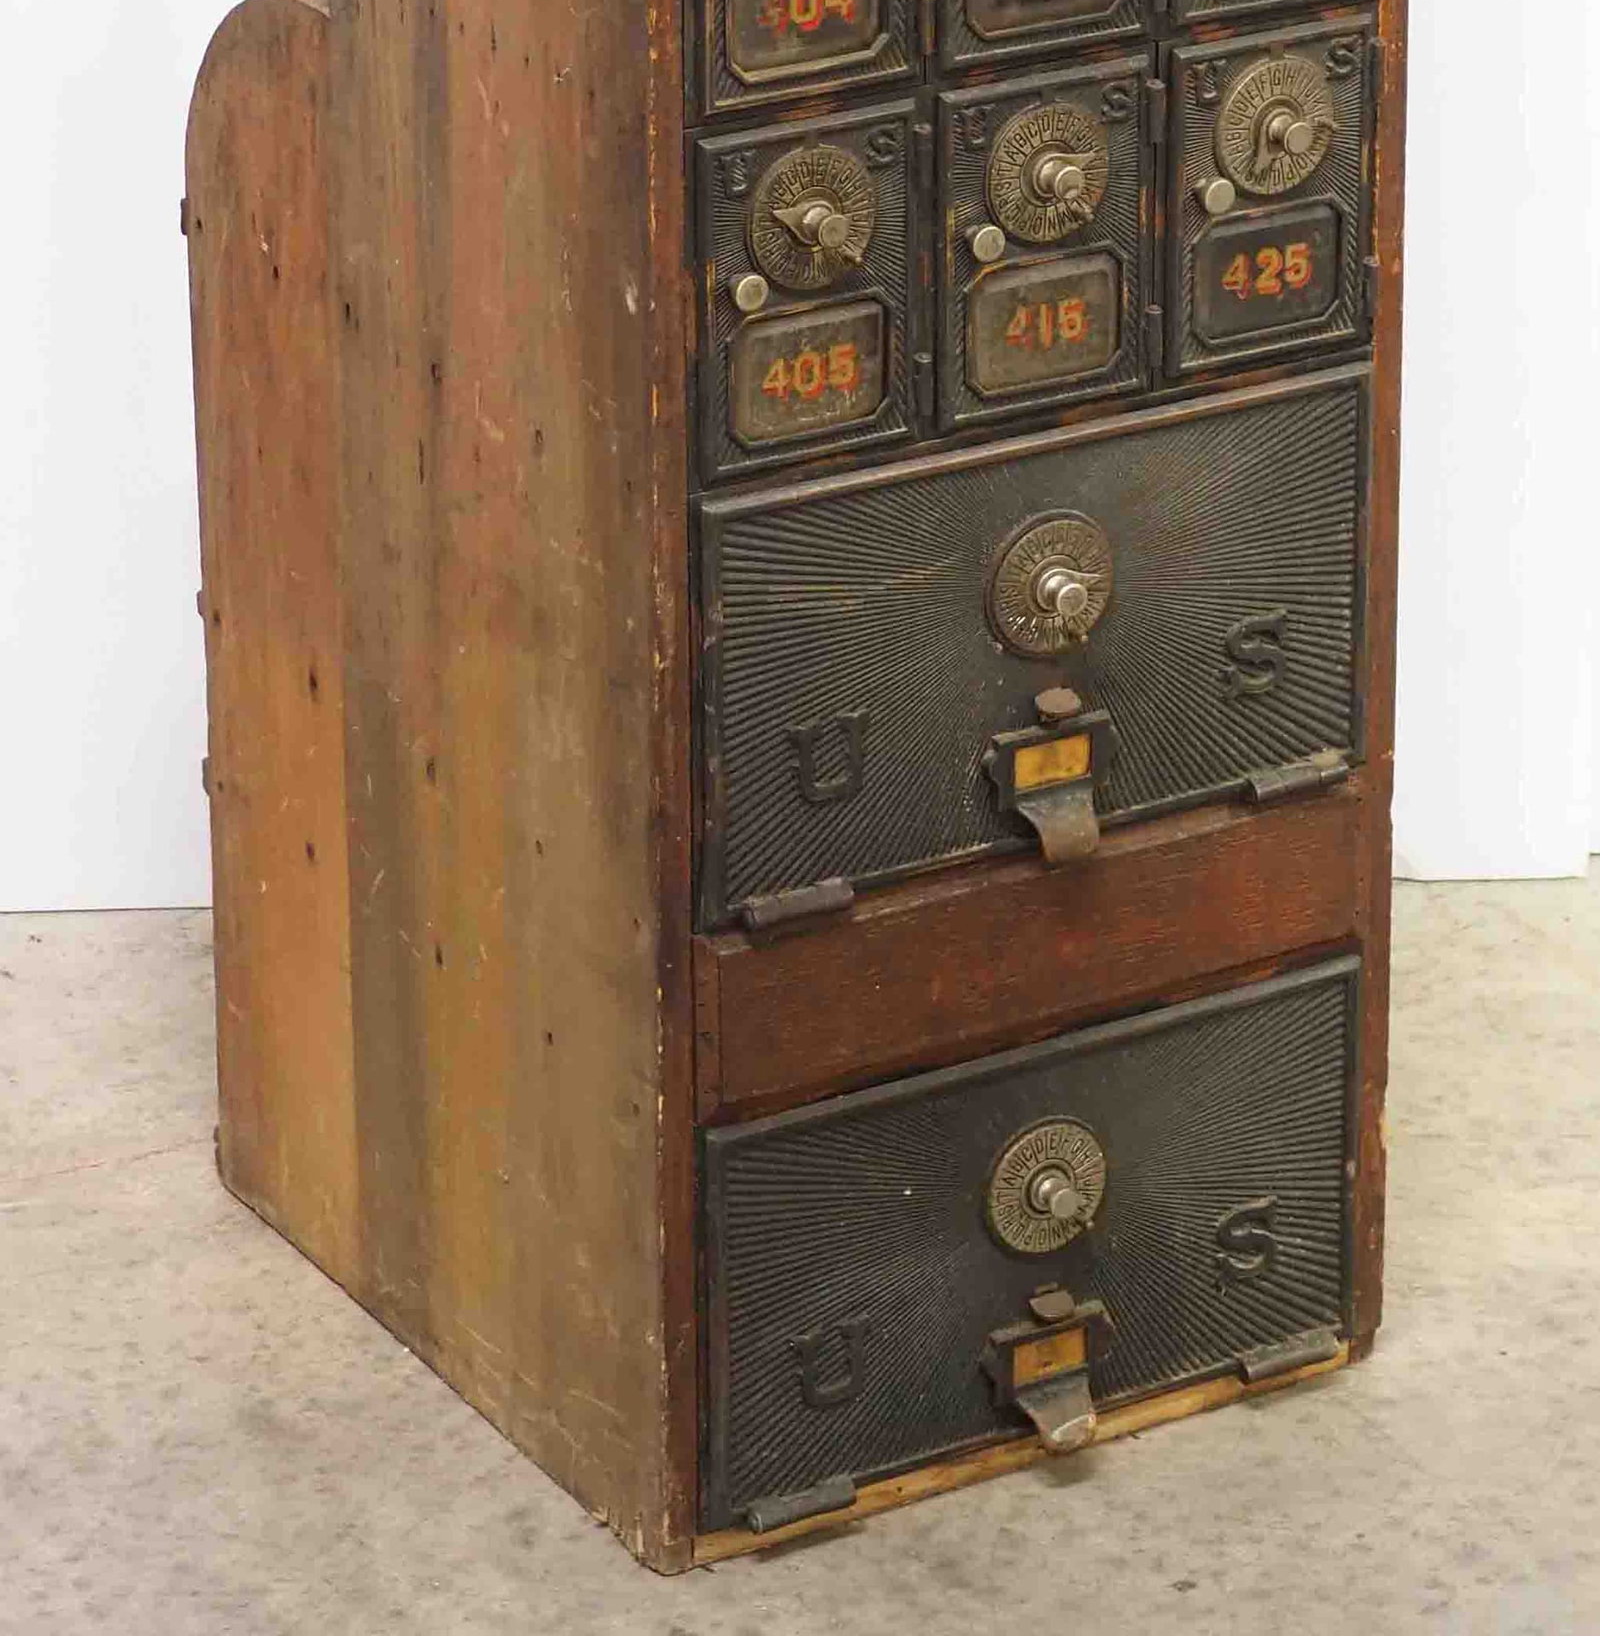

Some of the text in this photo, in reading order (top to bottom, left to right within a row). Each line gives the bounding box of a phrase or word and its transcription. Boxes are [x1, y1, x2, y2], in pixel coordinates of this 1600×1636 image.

[1222, 242, 1312, 300] 425
[761, 342, 861, 402] 405
[787, 608, 1289, 804] U S
[795, 1195, 1278, 1409] U S
